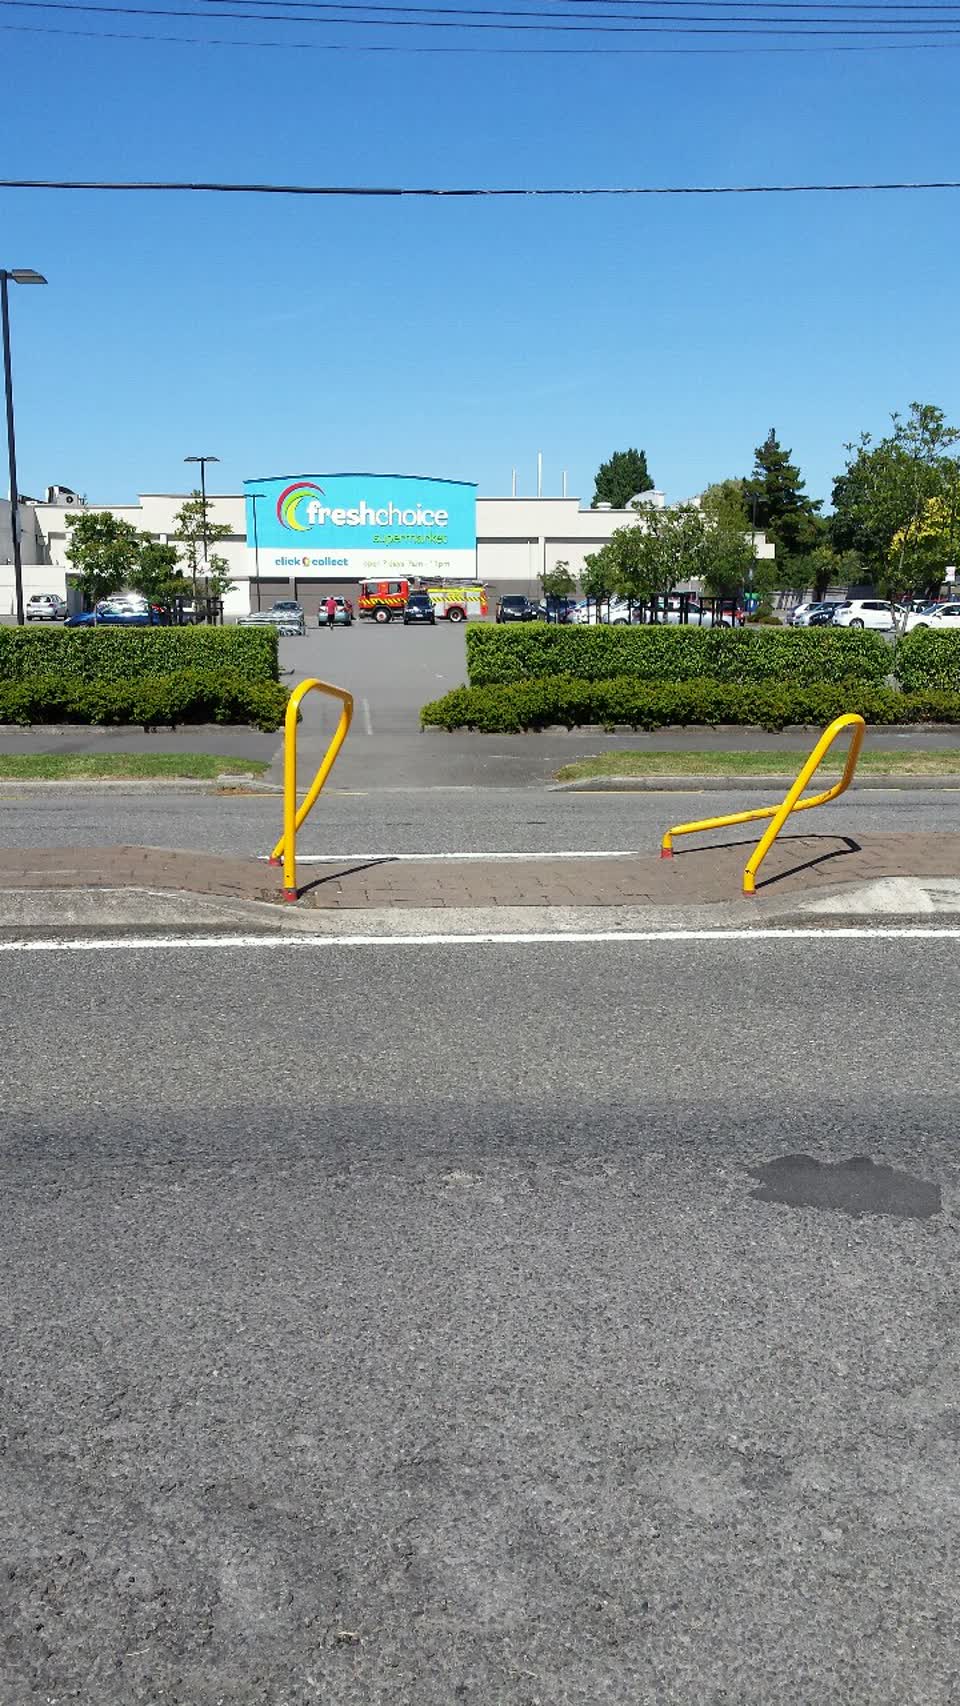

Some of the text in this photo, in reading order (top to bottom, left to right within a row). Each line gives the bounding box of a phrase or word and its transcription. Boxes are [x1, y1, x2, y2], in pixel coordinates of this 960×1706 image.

[306, 500, 448, 526] freshchoice
[373, 532, 448, 547] supermarket
[275, 557, 349, 567] click collect
